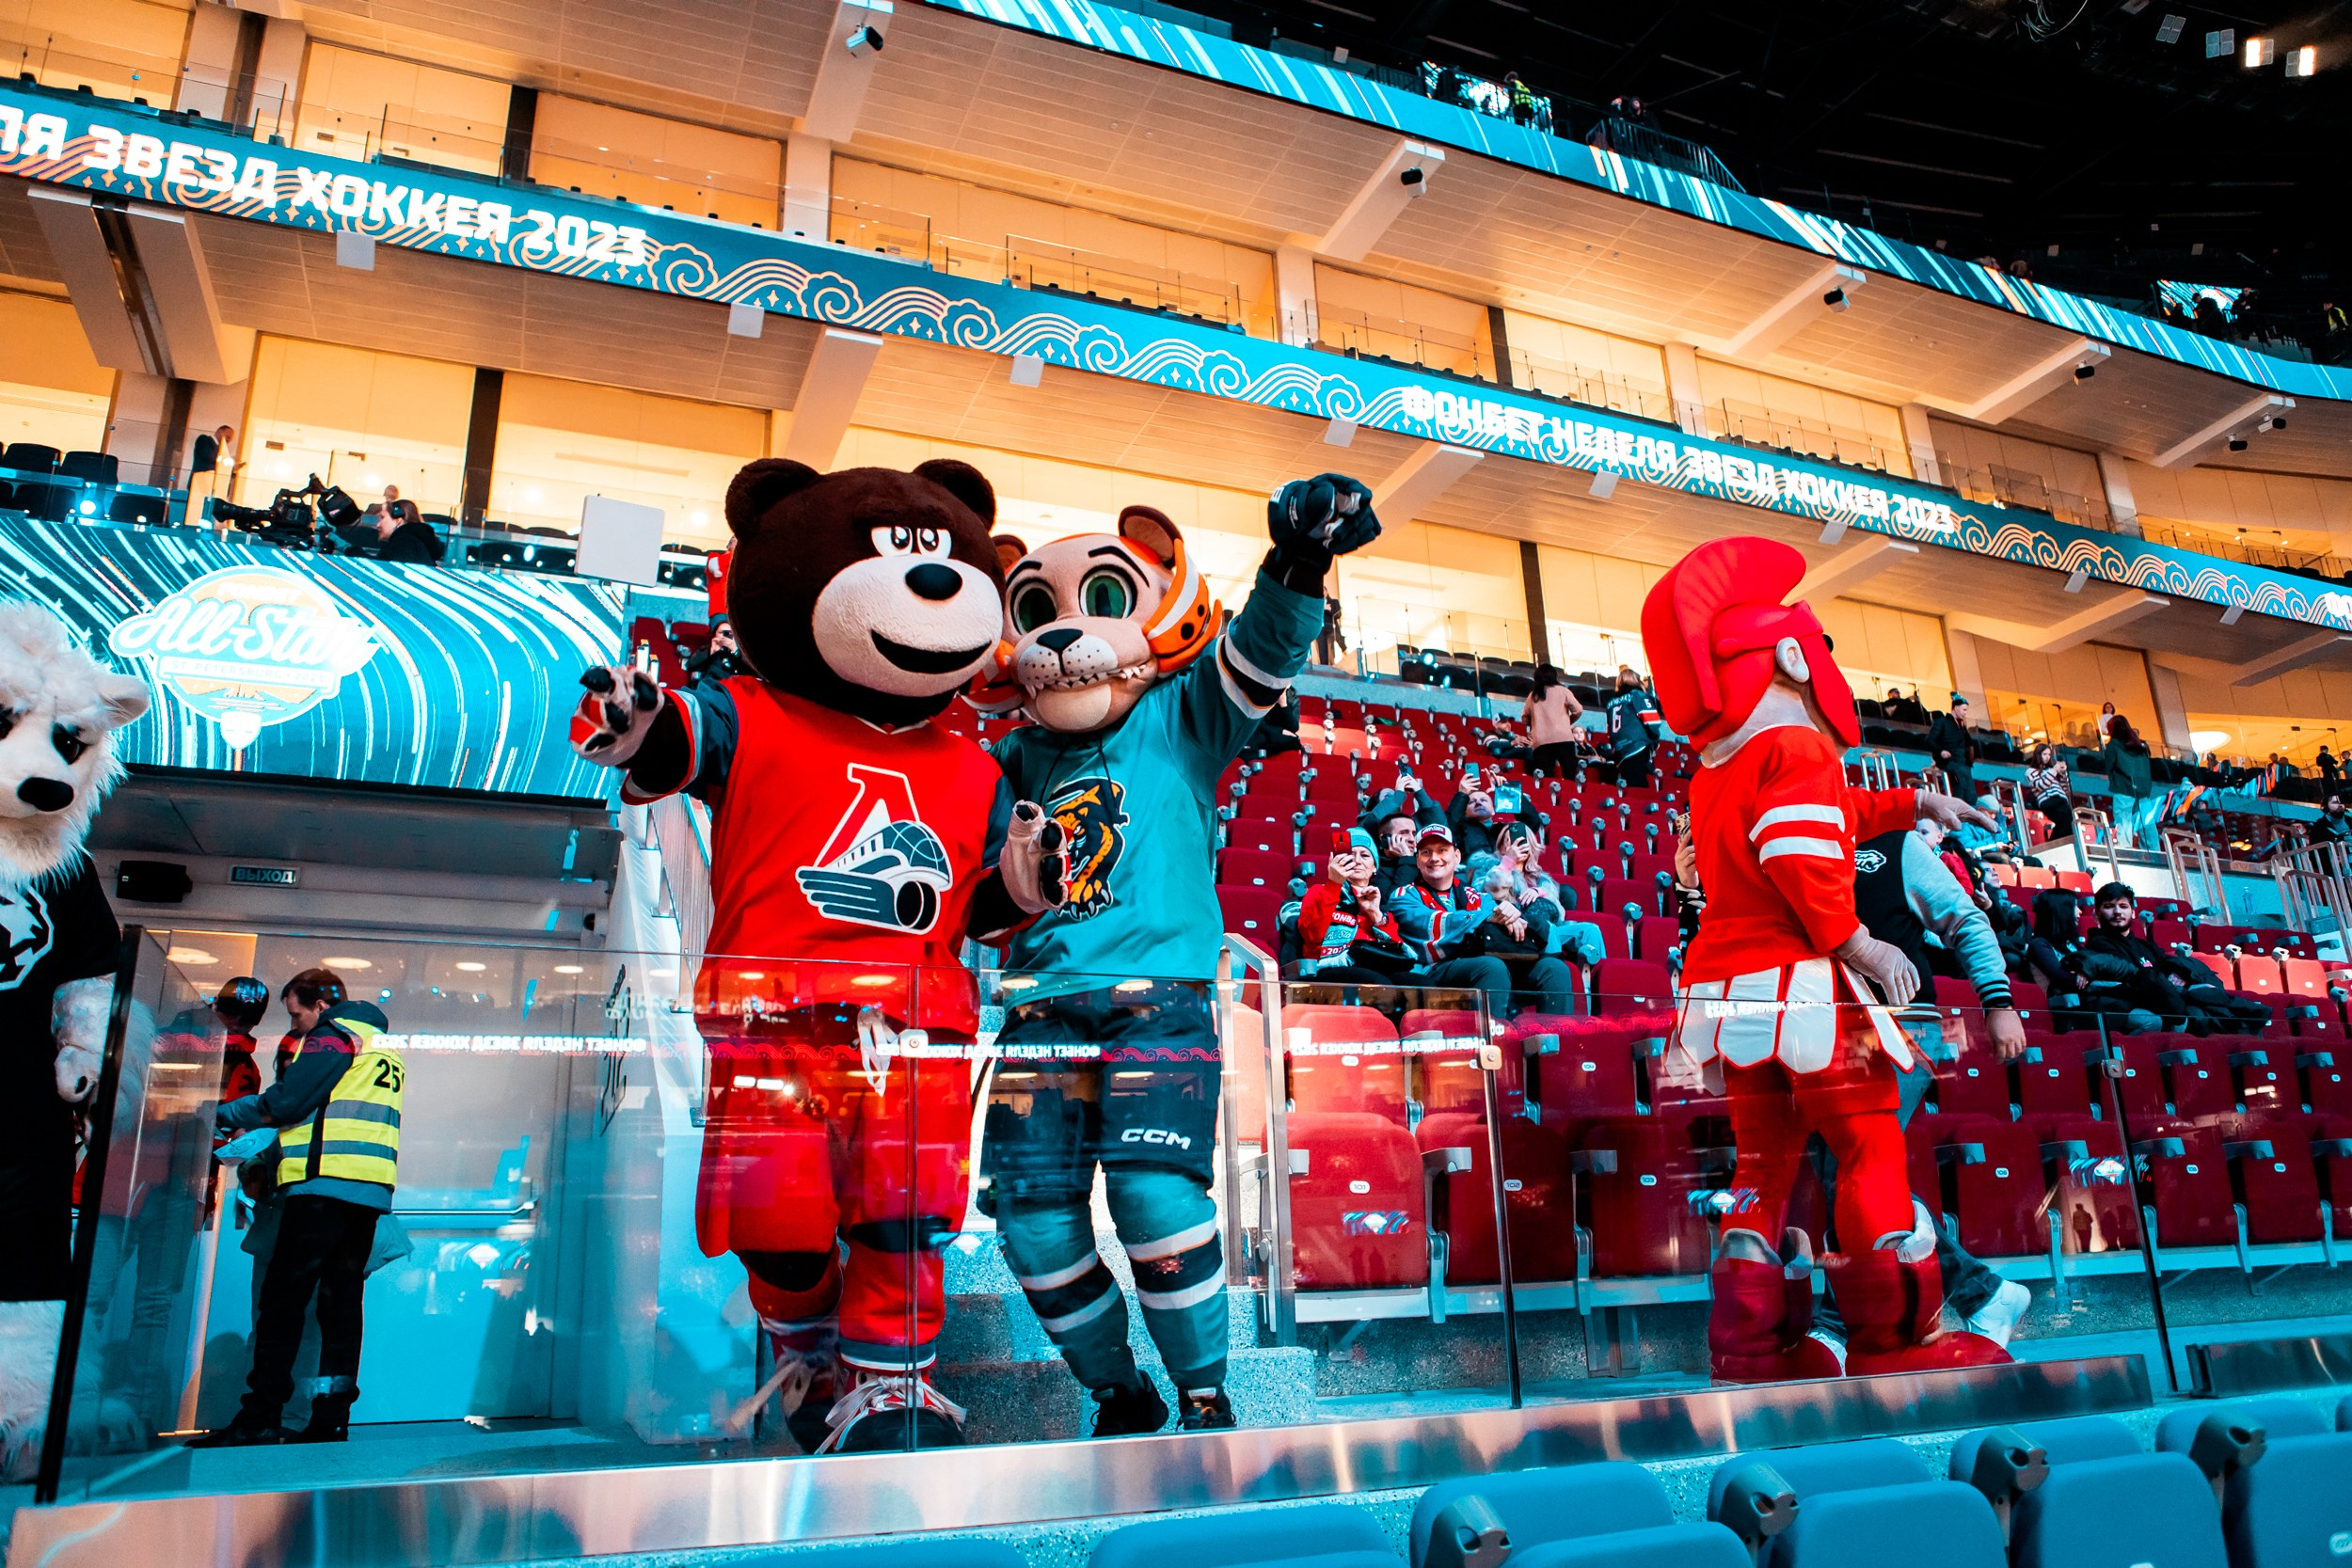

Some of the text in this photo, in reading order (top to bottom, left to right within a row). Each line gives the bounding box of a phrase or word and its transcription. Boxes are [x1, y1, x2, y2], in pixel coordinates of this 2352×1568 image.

[83, 124, 278, 208] ЗВЕЗД
[292, 166, 512, 244] ХОККЕЯ
[523, 209, 646, 267] 2023
[1402, 385, 1956, 533] ФОНБЕТ НЕДЕЛЯ ЗВЕЗД ХОККЕЯ 2023
[119, 598, 363, 664] All-Sta
[235, 868, 293, 883] ВЫХОД
[1120, 1128, 1191, 1149] CCM
